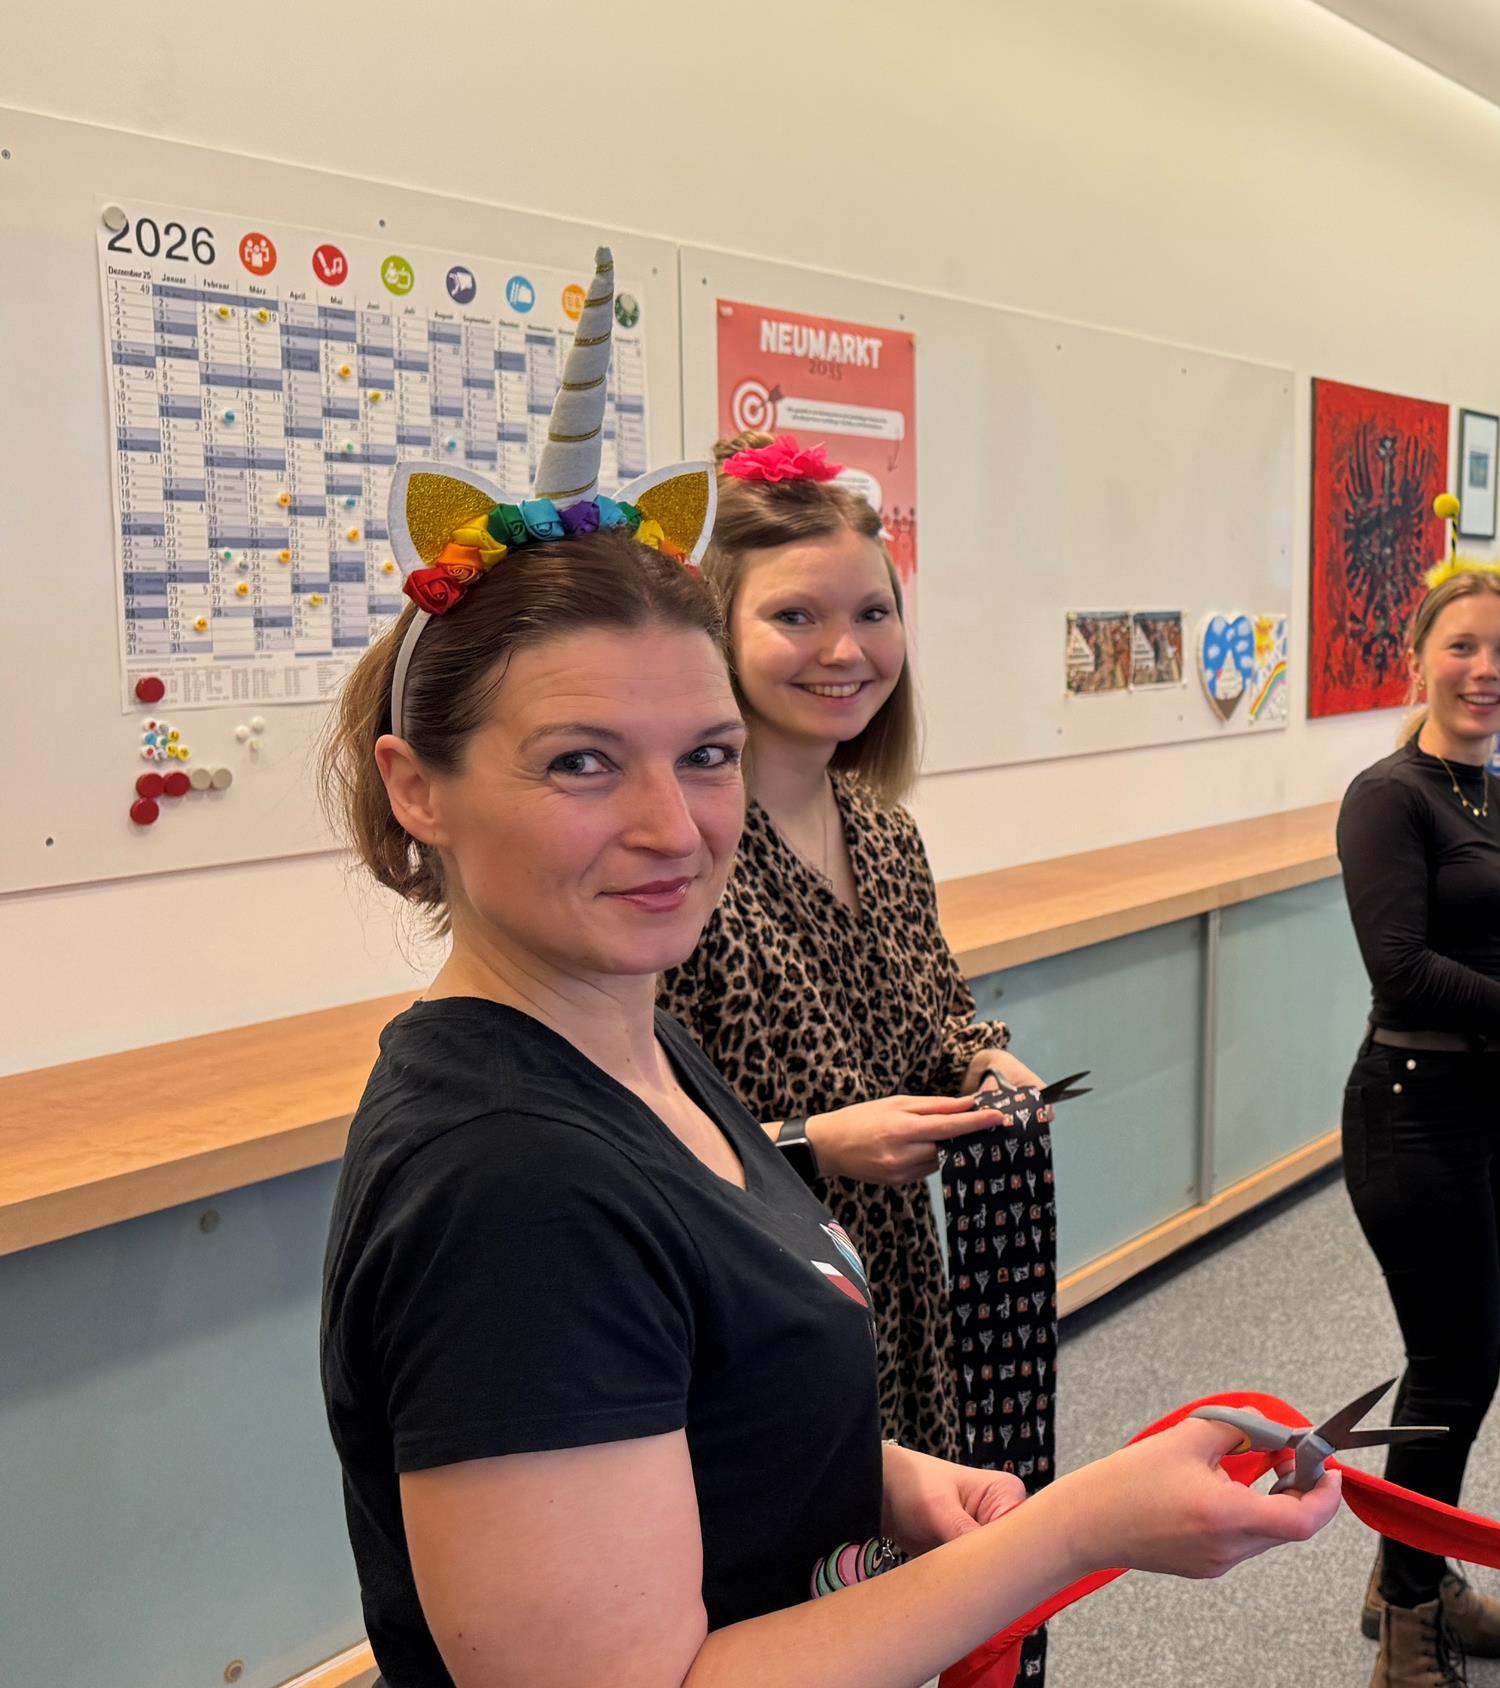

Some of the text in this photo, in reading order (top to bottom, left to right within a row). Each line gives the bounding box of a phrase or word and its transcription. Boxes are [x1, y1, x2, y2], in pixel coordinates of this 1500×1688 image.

[107, 217, 216, 265] 2026
[108, 265, 142, 278] Dezember
[759, 318, 883, 370] NEUMARKT
